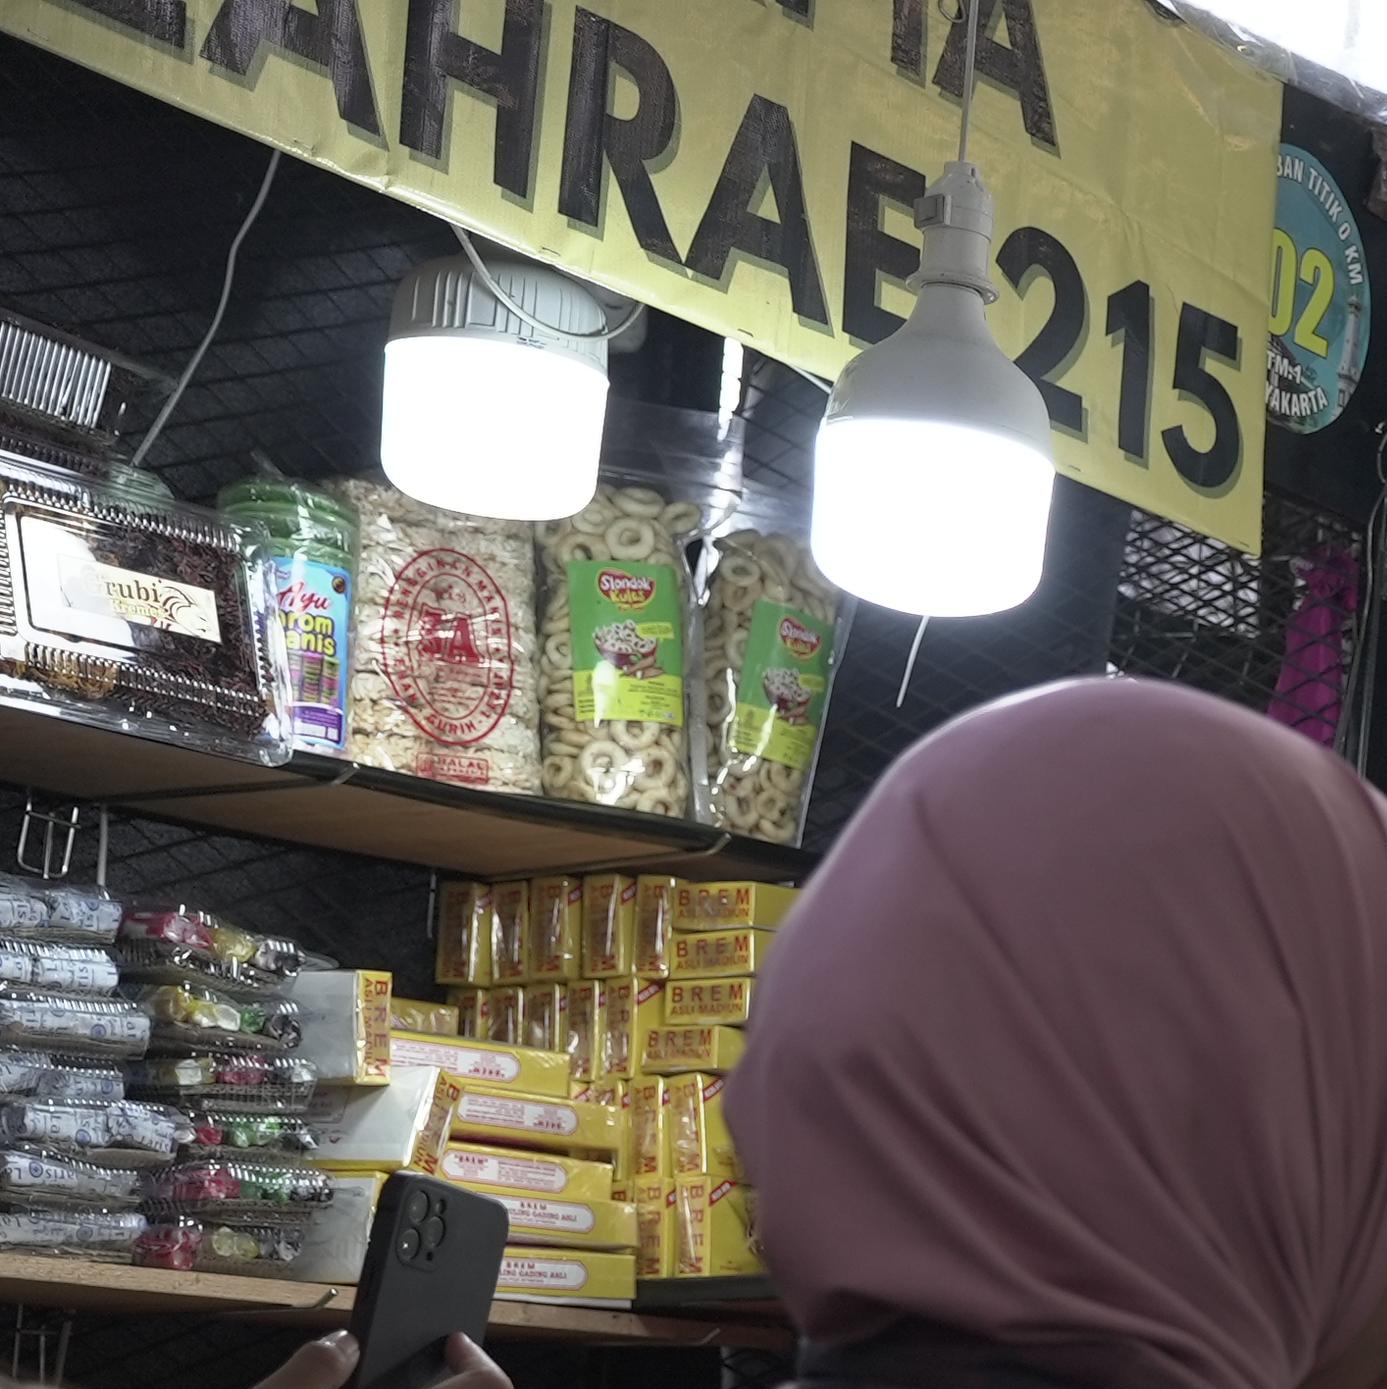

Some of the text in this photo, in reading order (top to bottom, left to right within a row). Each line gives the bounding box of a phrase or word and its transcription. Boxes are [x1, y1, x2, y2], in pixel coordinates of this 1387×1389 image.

[1308, 167, 1342, 222] TITIK
[1344, 245, 1363, 285] KM
[75, 0, 928, 346] AHRAE
[994, 226, 1244, 490] 215
[1268, 227, 1335, 360] 02
[277, 578, 332, 613] Ayu
[600, 572, 652, 591] Slondok
[287, 629, 336, 657] anis
[678, 887, 750, 907] BREM
[676, 935, 749, 958] BREM
[671, 983, 744, 1004] BREM
[373, 979, 388, 1080] BREM
[648, 1028, 713, 1048] BREM
[647, 1186, 661, 1275] BREM
[690, 1185, 705, 1274] BREM
